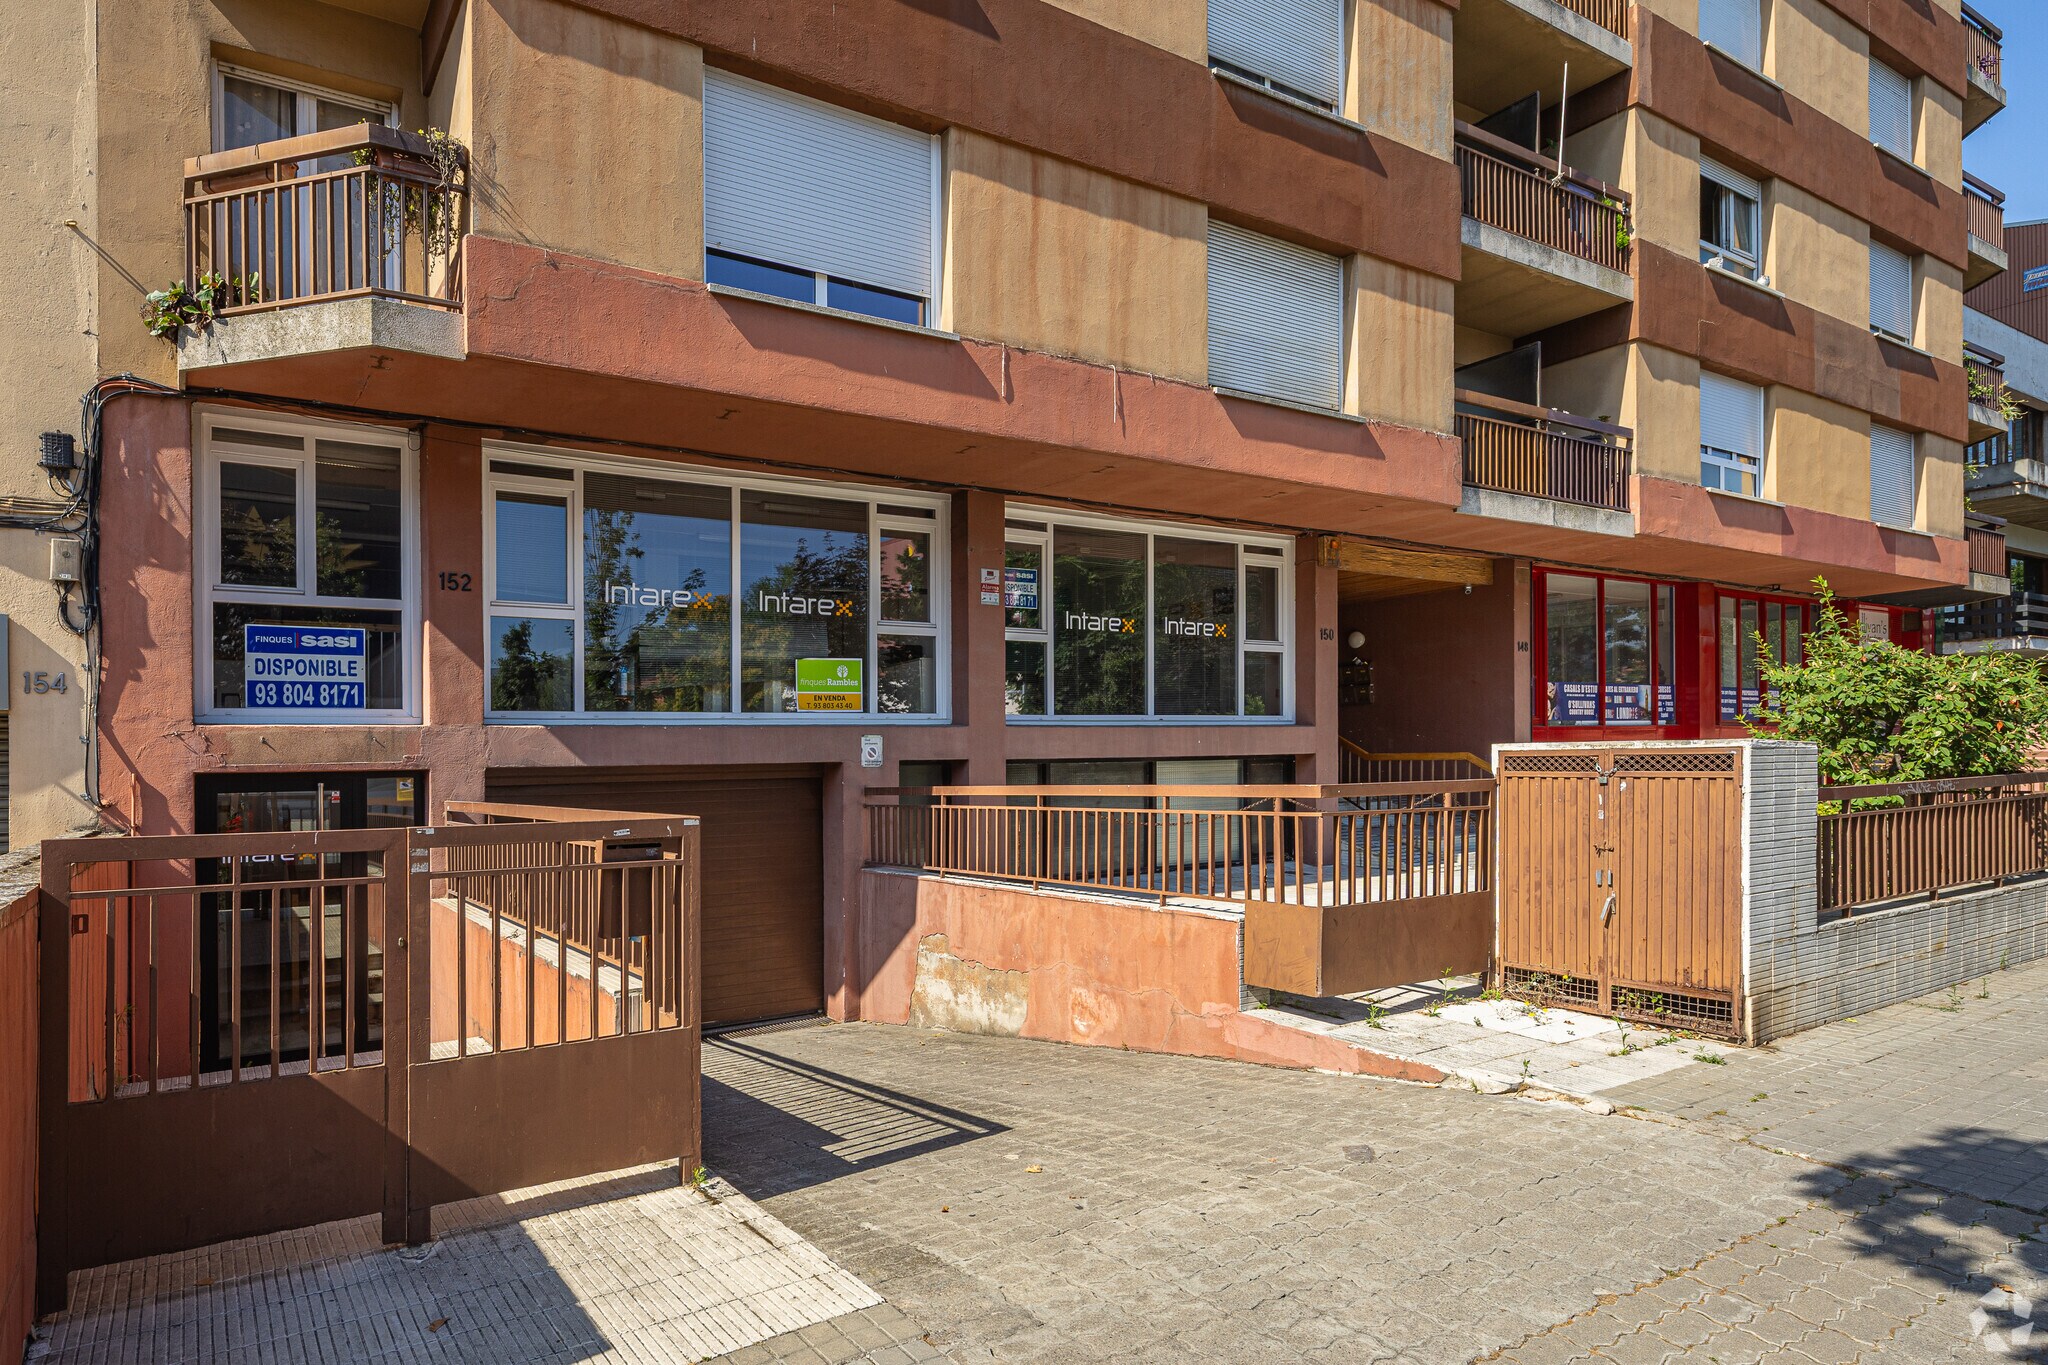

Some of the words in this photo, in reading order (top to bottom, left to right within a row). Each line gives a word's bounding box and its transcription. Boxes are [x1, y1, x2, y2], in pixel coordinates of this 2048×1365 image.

[439, 572, 472, 592] 152
[604, 580, 712, 609] Intarex
[759, 590, 853, 617] Intarex
[1065, 610, 1135, 634] Intarex
[1164, 616, 1227, 638] Intarex
[255, 635, 293, 644] FINQUES
[301, 635, 357, 648] sasi
[1320, 628, 1334, 641] 150
[1517, 641, 1529, 652] 148
[254, 658, 358, 677] DISPONIBLE
[23, 671, 67, 694] 154
[800, 678, 826, 687] finques
[827, 678, 859, 686] Rambles
[255, 683, 277, 705] 93
[283, 683, 314, 705] 804
[320, 684, 359, 706] 8171
